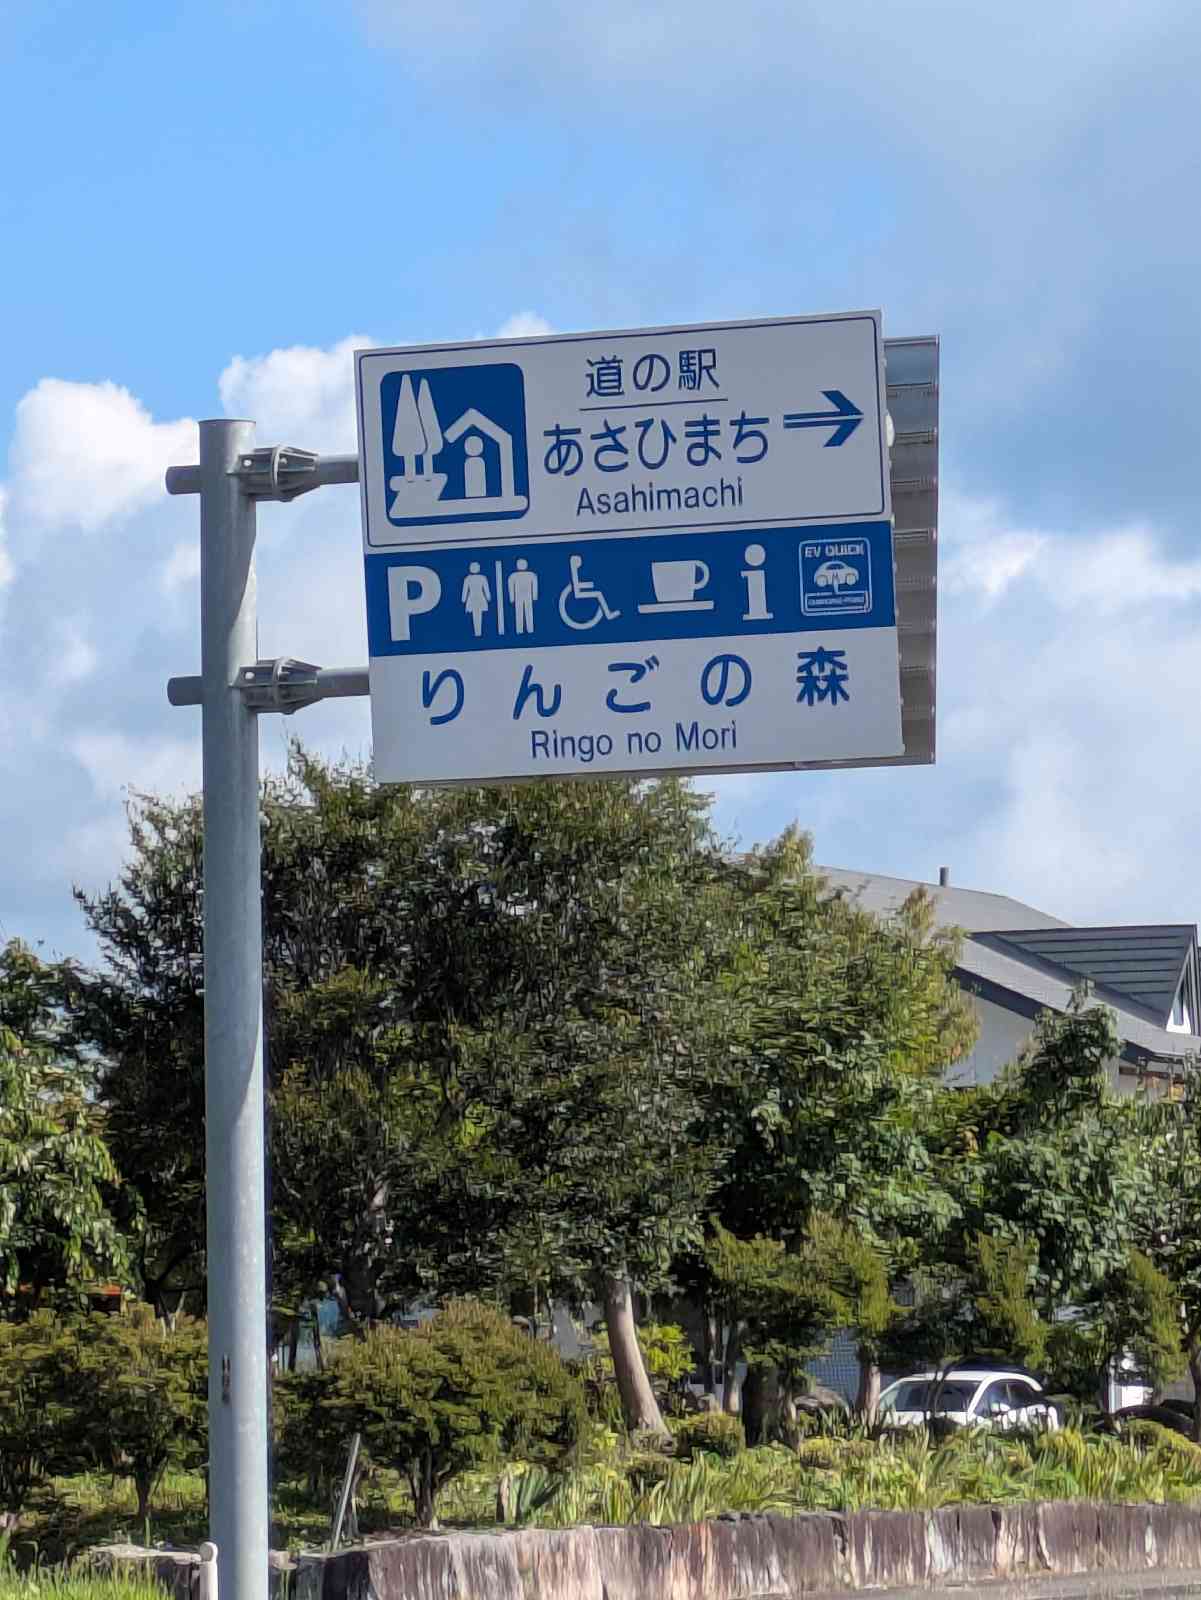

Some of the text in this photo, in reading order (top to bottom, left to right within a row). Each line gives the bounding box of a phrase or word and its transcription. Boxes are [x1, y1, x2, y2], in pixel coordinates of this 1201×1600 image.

[585, 348, 720, 397] 道の駅
[543, 410, 770, 477] あさひまち
[576, 477, 743, 516] Asahimachi
[804, 543, 864, 558] EV QUICK
[387, 565, 442, 642] P
[421, 646, 851, 725] りんごの森
[530, 720, 737, 763] Ringo no Mori
